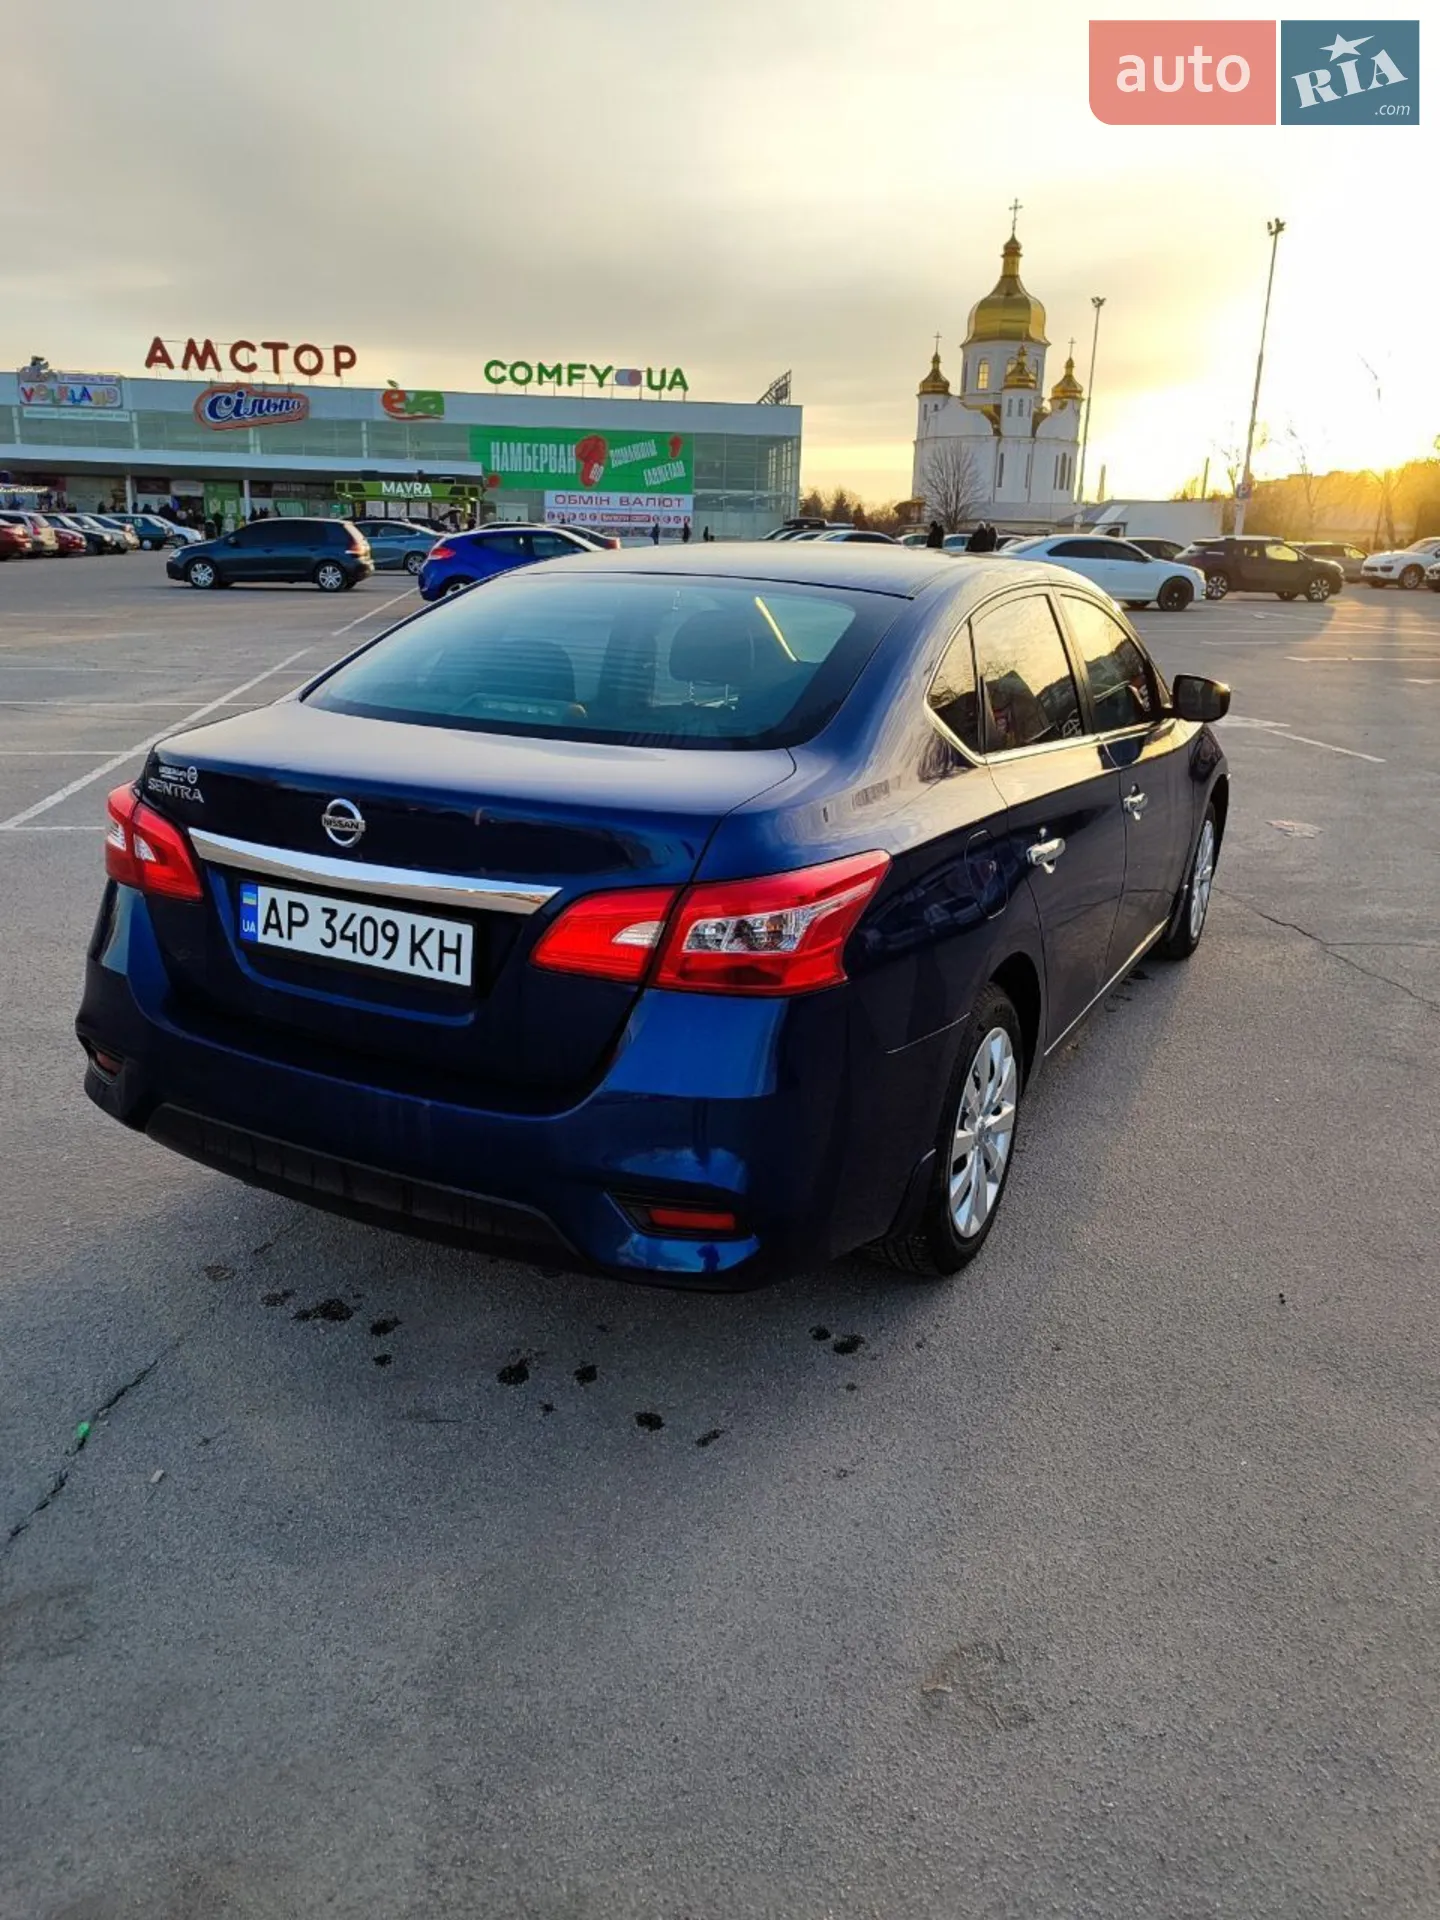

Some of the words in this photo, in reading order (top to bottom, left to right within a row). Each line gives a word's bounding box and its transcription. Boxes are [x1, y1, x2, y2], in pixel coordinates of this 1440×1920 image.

[144, 336, 357, 377] АМСТОР
[484, 359, 613, 389] COMFY
[490, 441, 577, 474] НАМБЕРВАН
[382, 481, 432, 495] MAVRA
[554, 494, 611, 506] ОБМІН
[148, 777, 205, 803] SENTRA
[323, 816, 360, 830] NISSAN
[242, 921, 256, 933] UA
[319, 907, 400, 960] 3409
